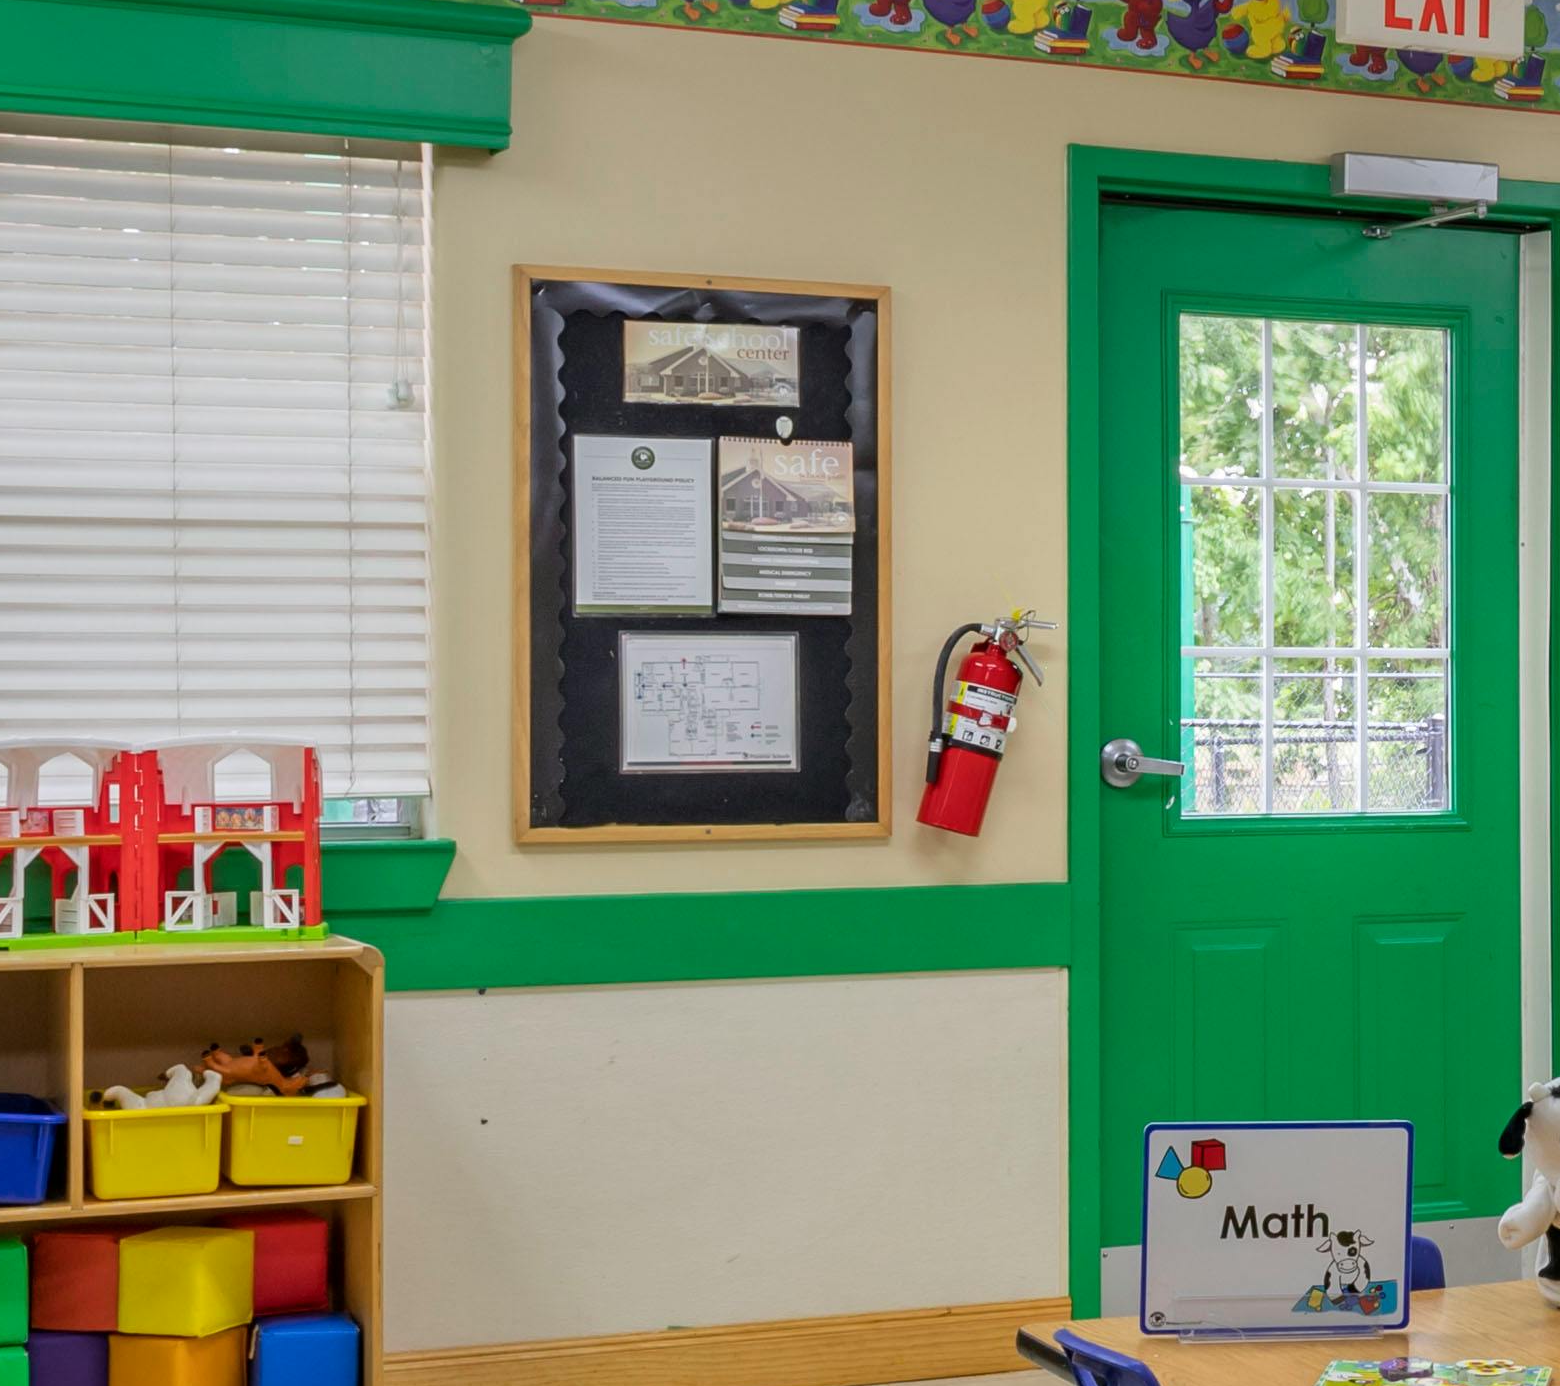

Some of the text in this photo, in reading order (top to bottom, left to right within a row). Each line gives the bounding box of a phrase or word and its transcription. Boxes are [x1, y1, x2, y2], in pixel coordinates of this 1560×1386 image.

[648, 326, 697, 347] safe
[736, 347, 790, 361] center
[773, 448, 840, 477] safe
[1220, 1204, 1330, 1240] Math
